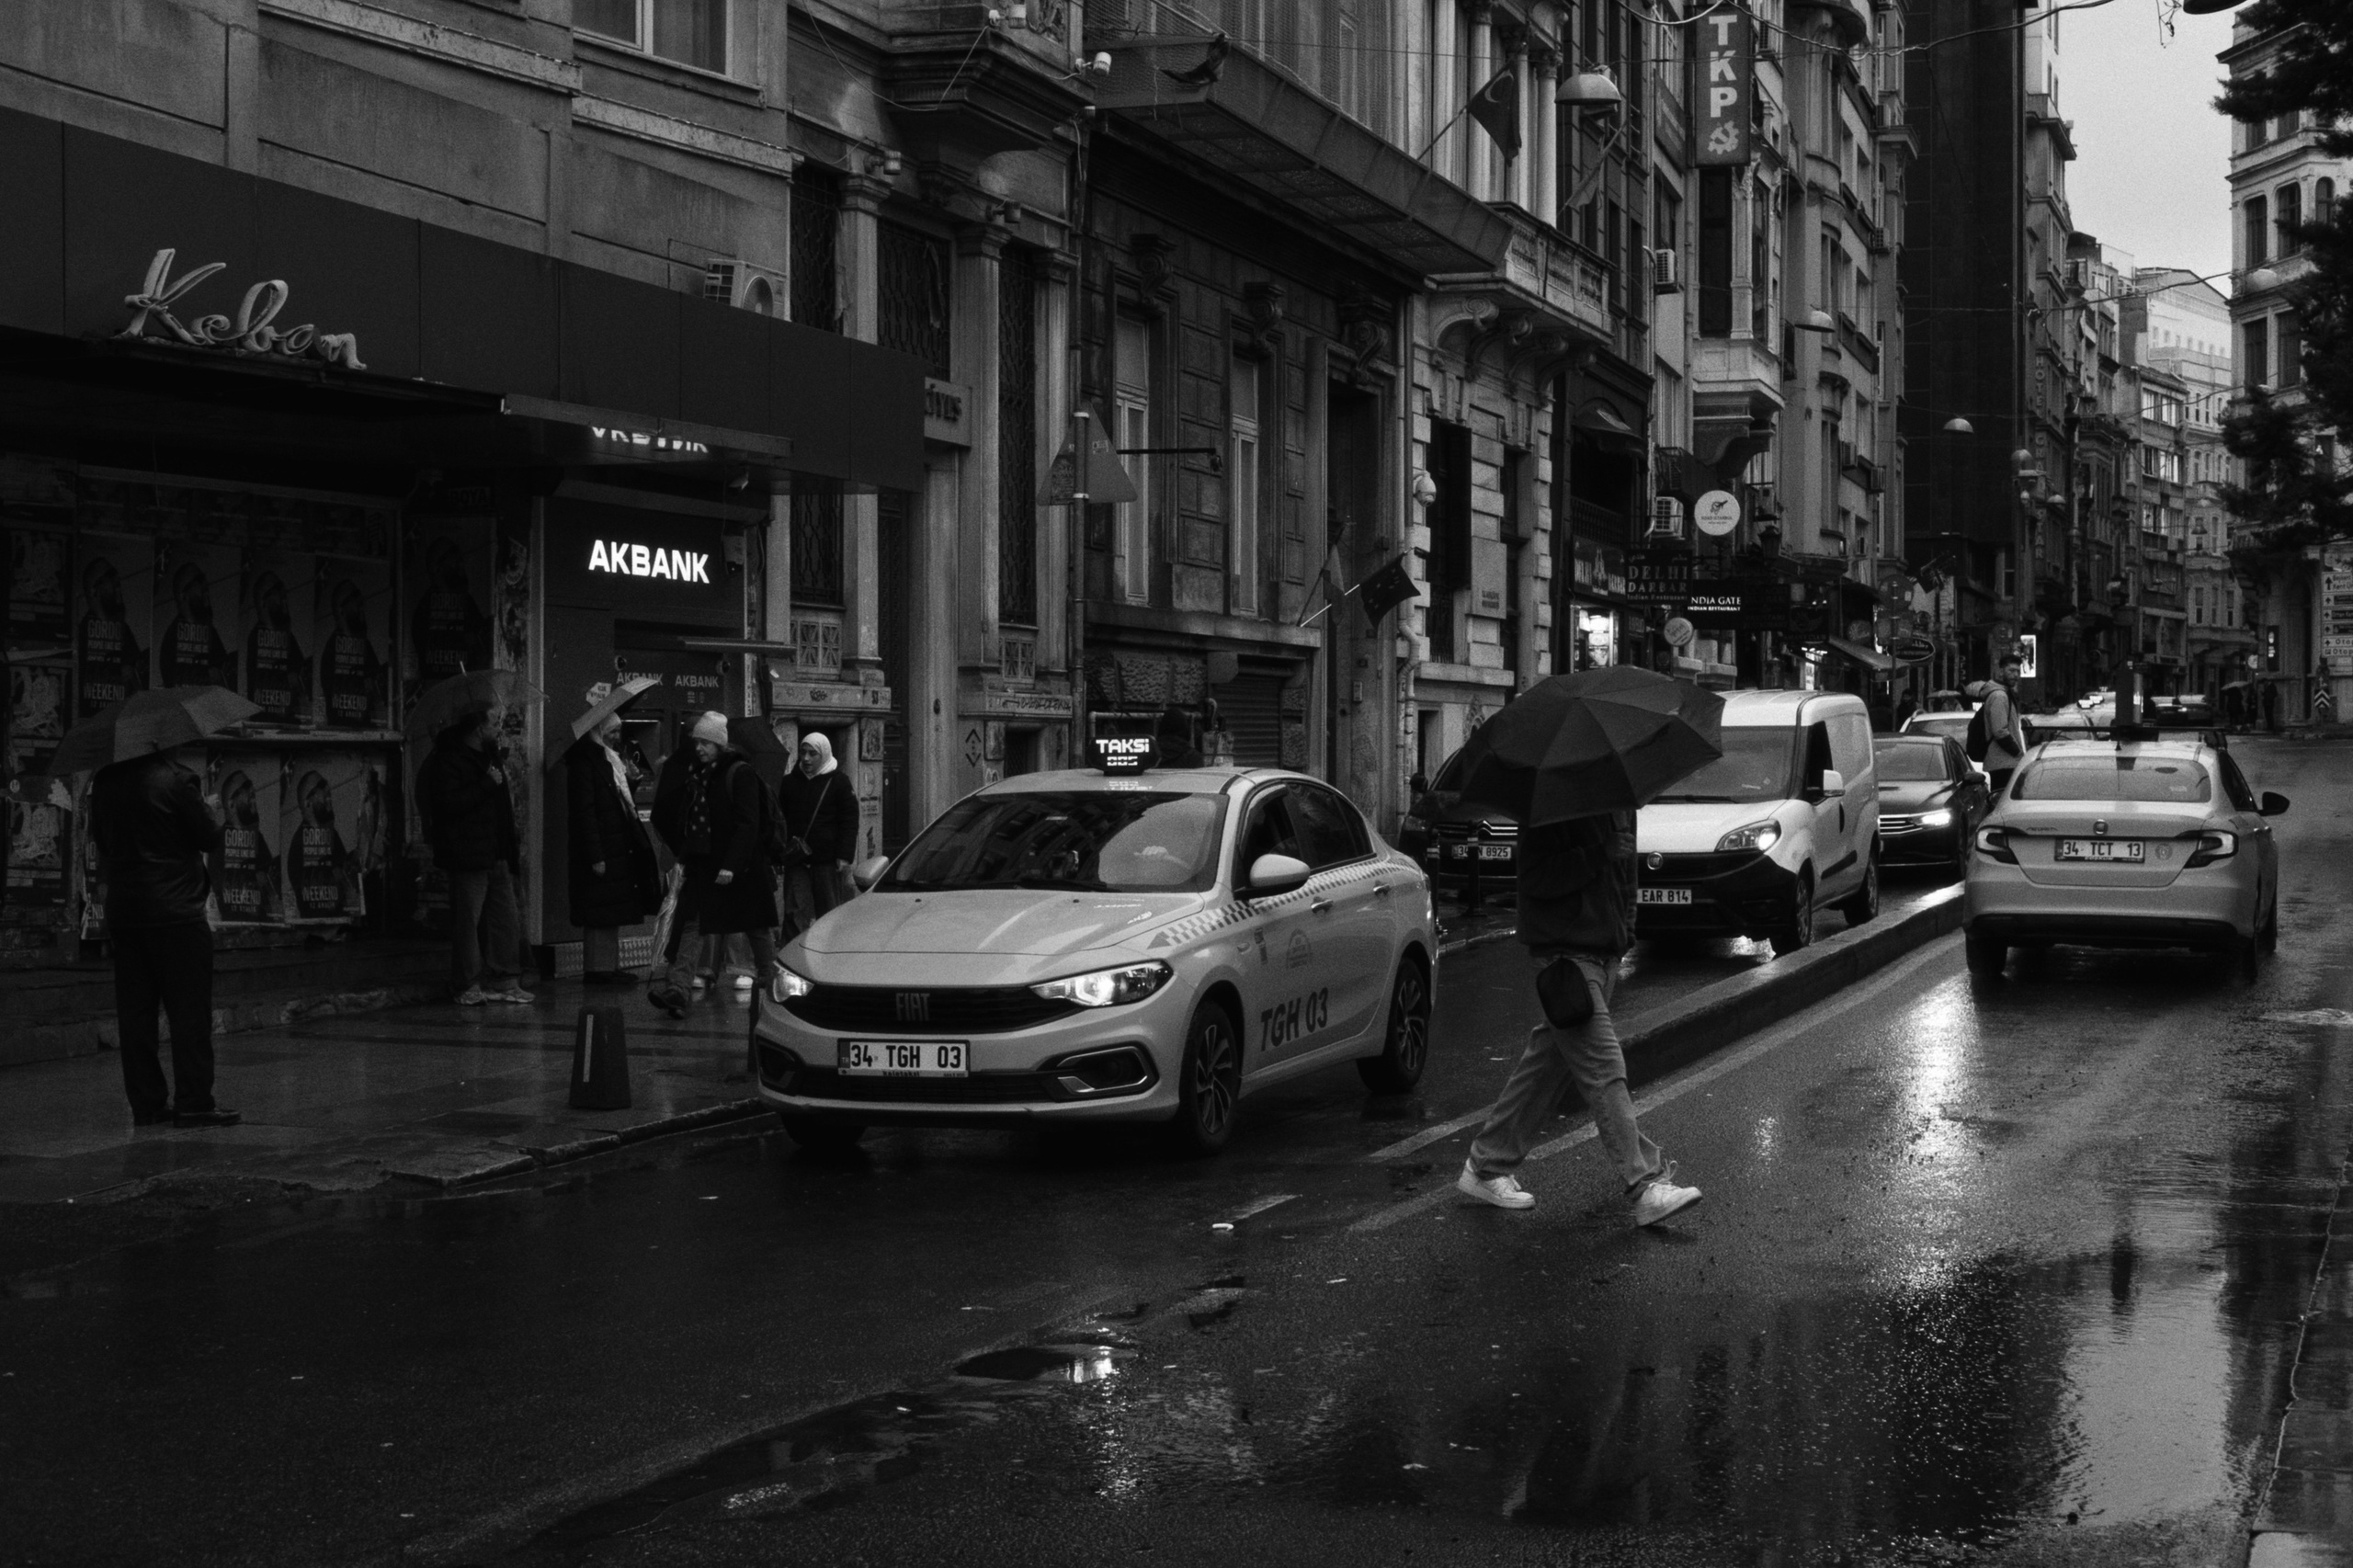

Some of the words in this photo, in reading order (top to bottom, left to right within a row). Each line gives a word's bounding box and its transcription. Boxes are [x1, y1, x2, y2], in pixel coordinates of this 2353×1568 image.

[1708, 14, 1739, 119] TKP
[588, 539, 710, 585] AKBANK
[1628, 565, 1688, 580] DELHI
[1628, 581, 1688, 593] DARBAR
[1717, 596, 1742, 606] GATE
[675, 675, 720, 687] AKBANK
[84, 682, 125, 700] WEEKEND
[254, 688, 291, 706] WEEKEND
[332, 694, 368, 711] WEEKEND
[1485, 846, 1509, 858] 8925
[2063, 841, 2079, 855] 34
[2090, 843, 2113, 856] TCT
[2126, 844, 2141, 856] 13
[222, 888, 261, 905] WEEKEND
[301, 885, 339, 903] WEEKEND
[1642, 890, 1663, 902] EAR
[1667, 890, 1688, 903] 814
[895, 993, 930, 1021] FIAT
[1261, 997, 1302, 1051] TGH
[1305, 987, 1328, 1032] 03
[851, 1044, 873, 1067] 34
[886, 1045, 920, 1068] TGH
[938, 1046, 961, 1068] 03
